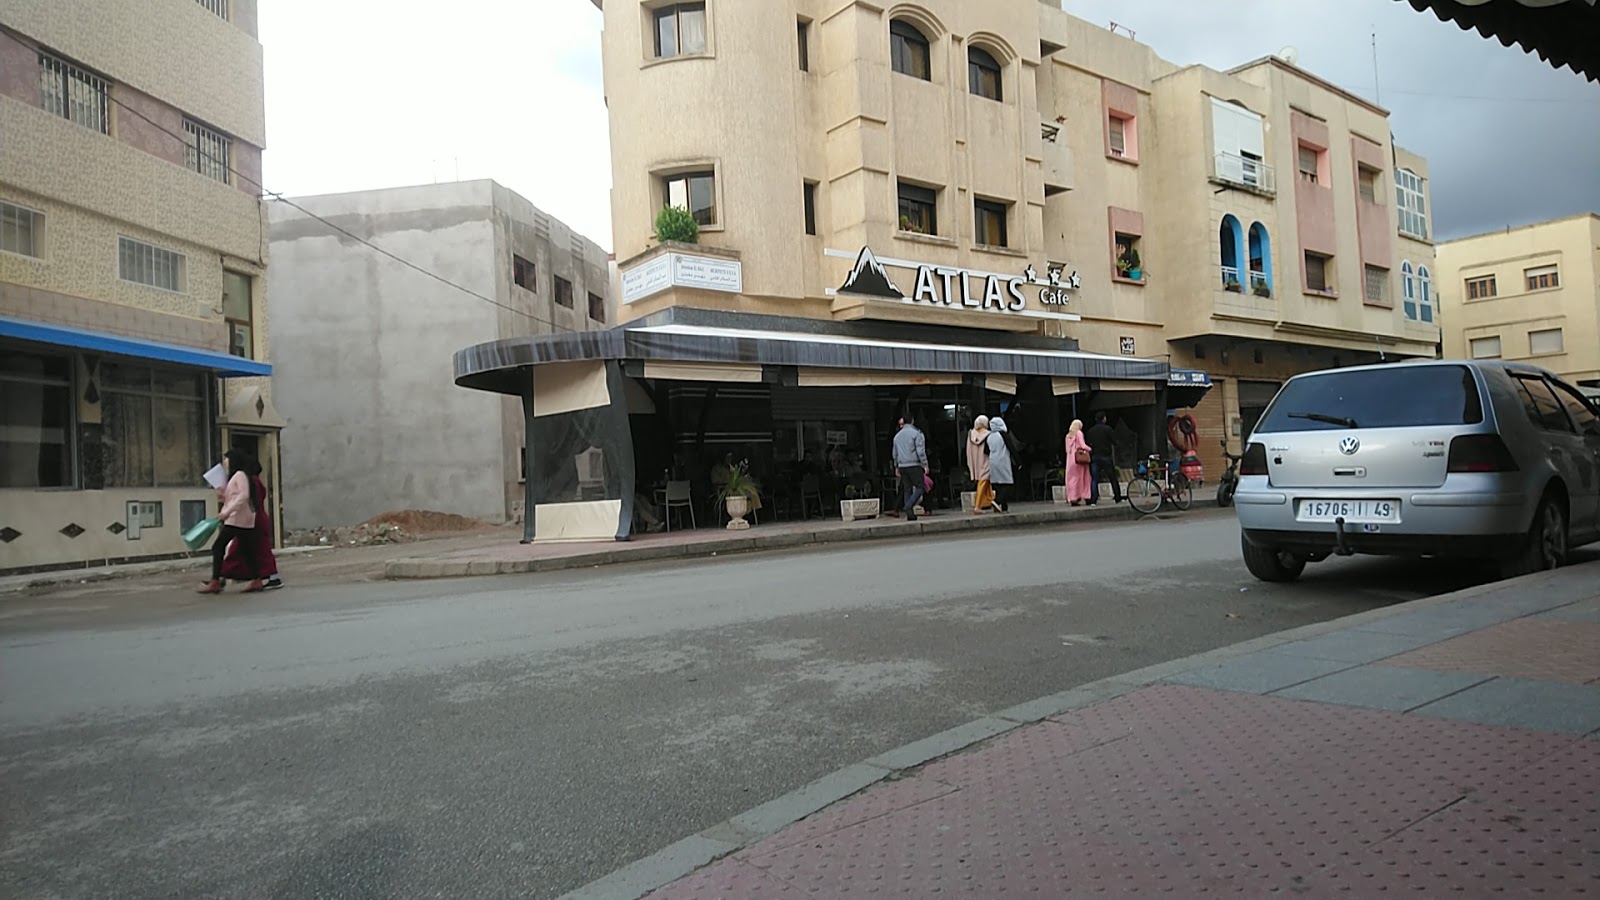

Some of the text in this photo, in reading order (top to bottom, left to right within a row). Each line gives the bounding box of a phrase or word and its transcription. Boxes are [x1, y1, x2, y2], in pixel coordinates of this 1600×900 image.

[912, 264, 1070, 311] ATLAS Cafe
[1308, 502, 1349, 516] 16706
